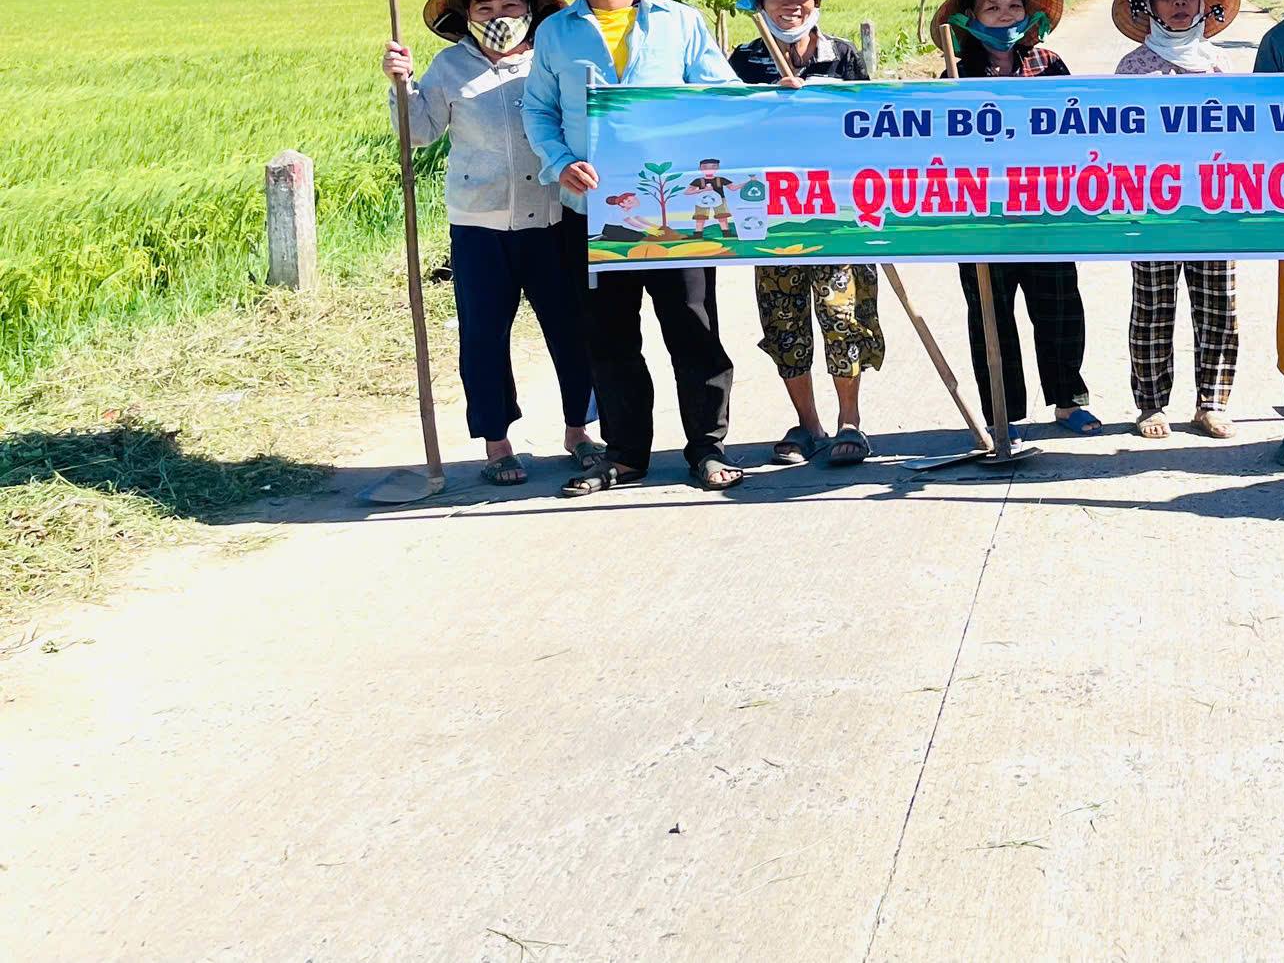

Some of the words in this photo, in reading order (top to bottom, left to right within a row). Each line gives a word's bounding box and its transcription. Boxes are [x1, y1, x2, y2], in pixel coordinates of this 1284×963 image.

[844, 103, 931, 139] CÁN
[947, 101, 1015, 143] BỘ,
[1029, 97, 1145, 135] ĐẢNG
[1160, 99, 1255, 133] VIÊN
[766, 170, 836, 216] RA
[852, 157, 988, 227] QUÂN
[1007, 151, 1182, 212] HƯỞNG
